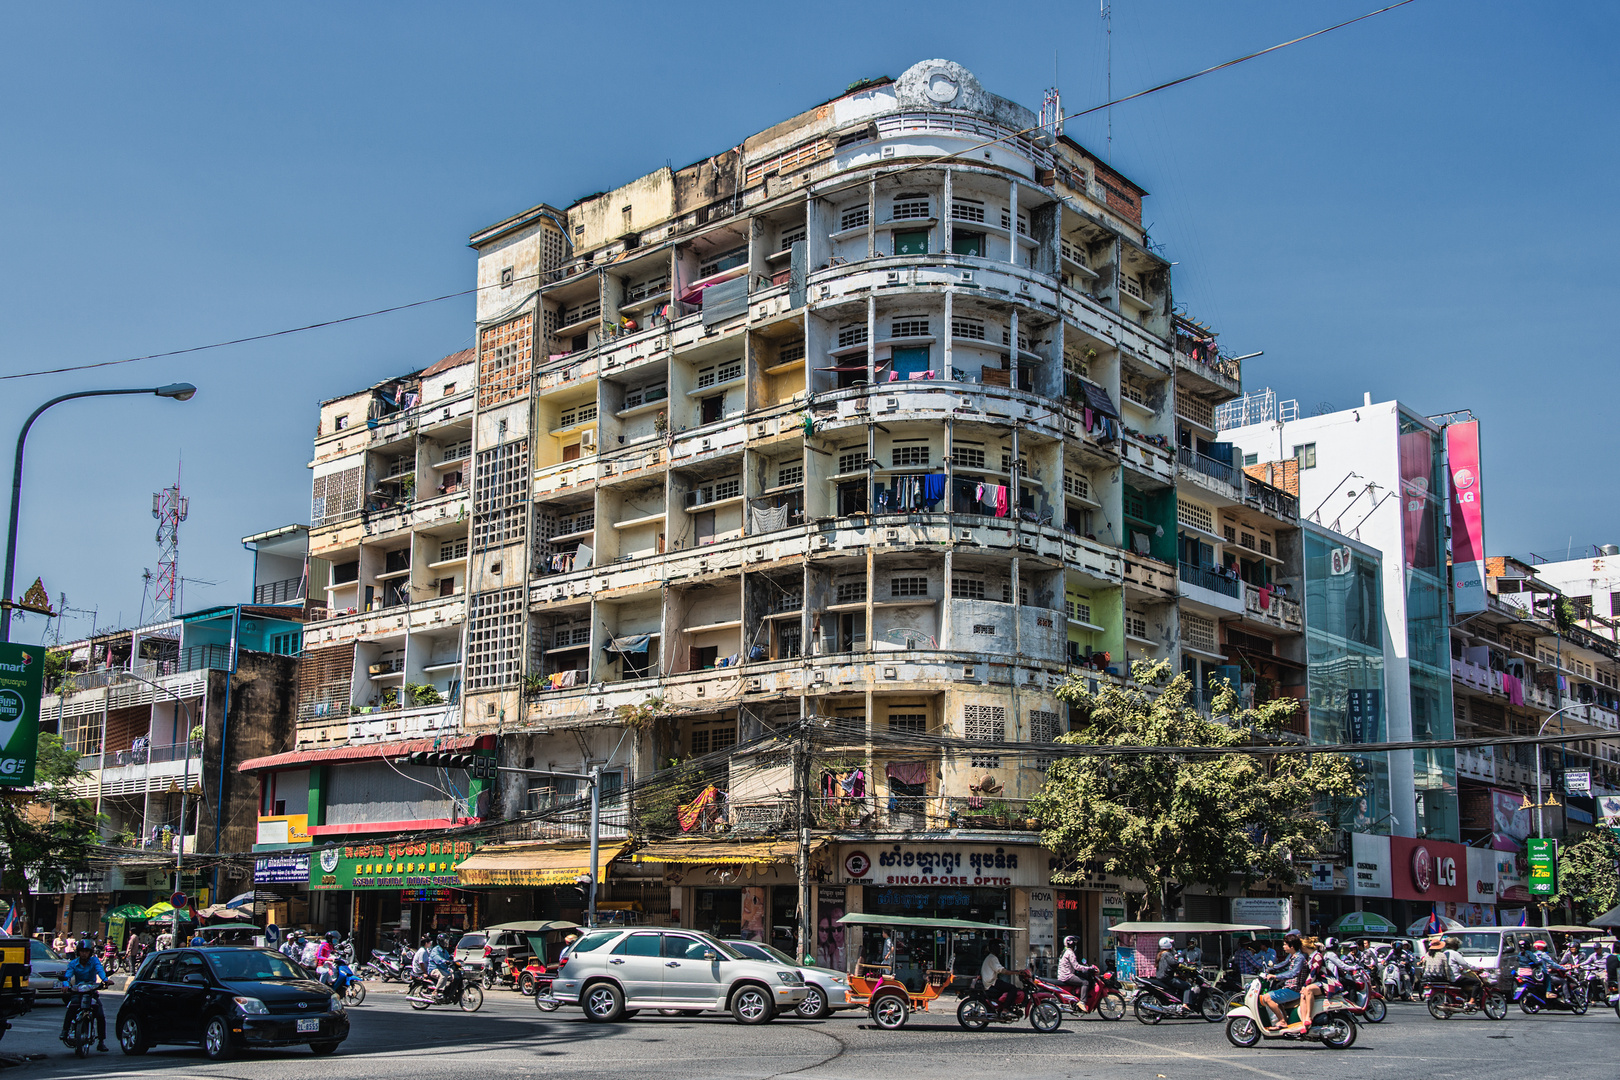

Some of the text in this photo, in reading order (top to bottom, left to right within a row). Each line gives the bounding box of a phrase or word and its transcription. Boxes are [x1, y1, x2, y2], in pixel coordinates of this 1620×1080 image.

[1456, 492, 1474, 503] LG
[16, 758, 27, 774] LTE
[1356, 862, 1378, 871] CUSTOMER
[1436, 857, 1456, 887] LG
[352, 877, 375, 887] ASEAN
[376, 876, 404, 887] DIGITAL
[406, 875, 431, 886] IMAGE
[886, 875, 968, 886] SINGAPORE
[973, 876, 1011, 886] OPTIC
[1356, 872, 1373, 880] SERVICE
[1031, 892, 1052, 901] HOYA
[1104, 896, 1122, 905] HOYA
